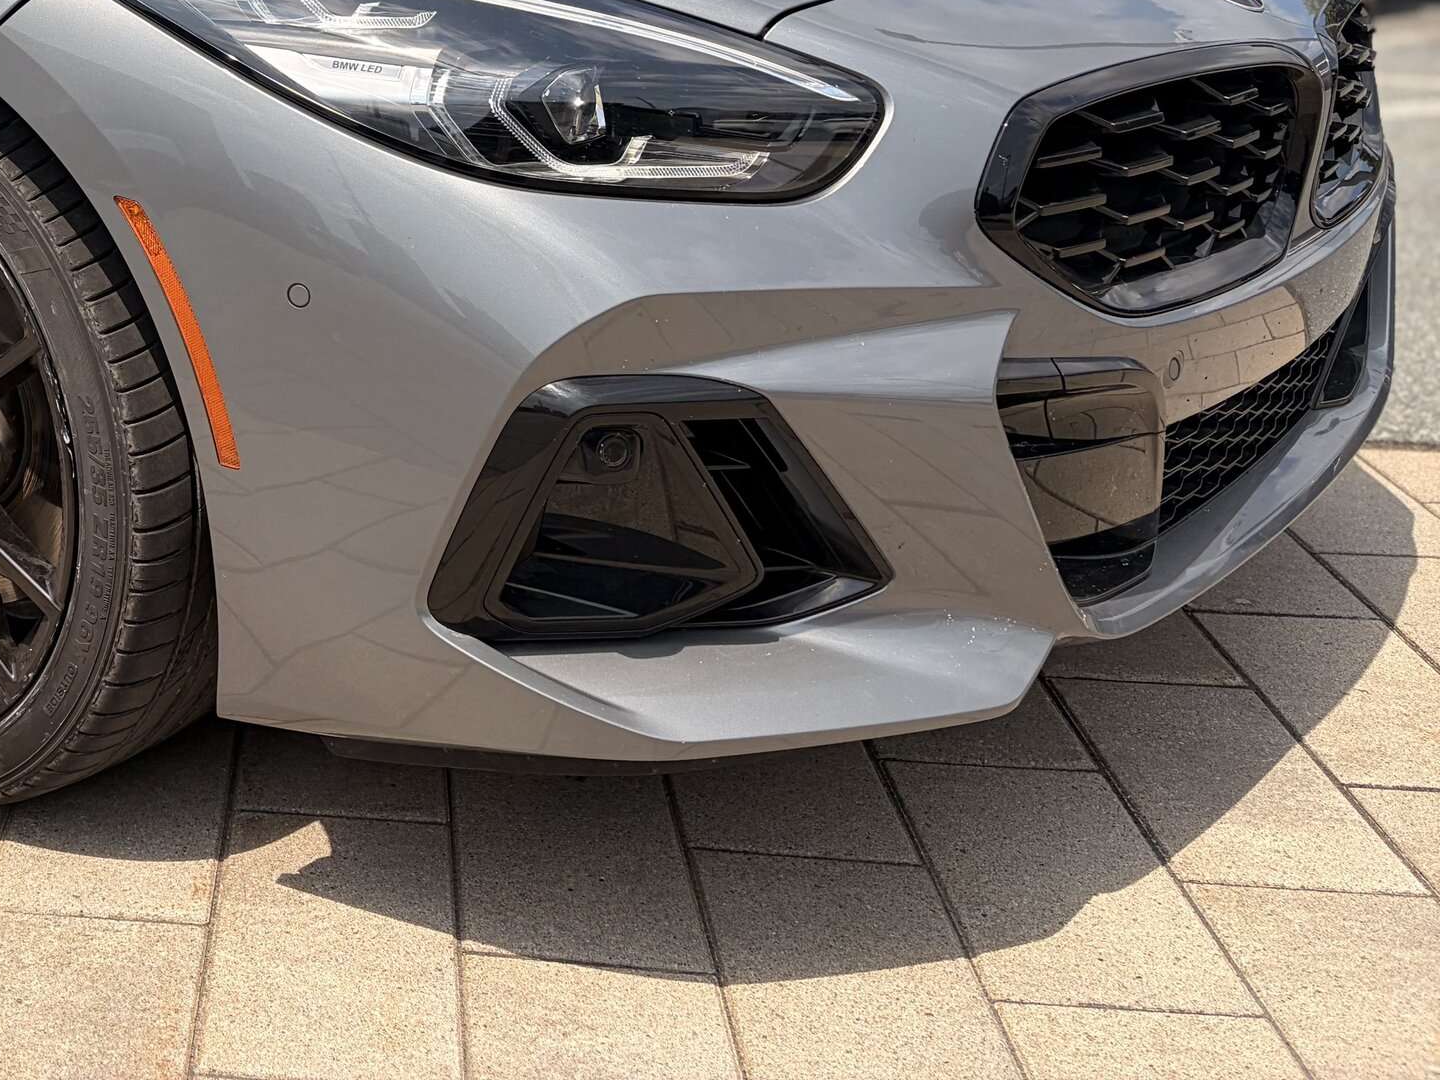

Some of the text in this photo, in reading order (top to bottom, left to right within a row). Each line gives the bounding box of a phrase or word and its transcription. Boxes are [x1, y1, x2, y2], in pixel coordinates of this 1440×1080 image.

[332, 60, 383, 74] BMW LED
[46, 663, 78, 715] OUTSIDE
